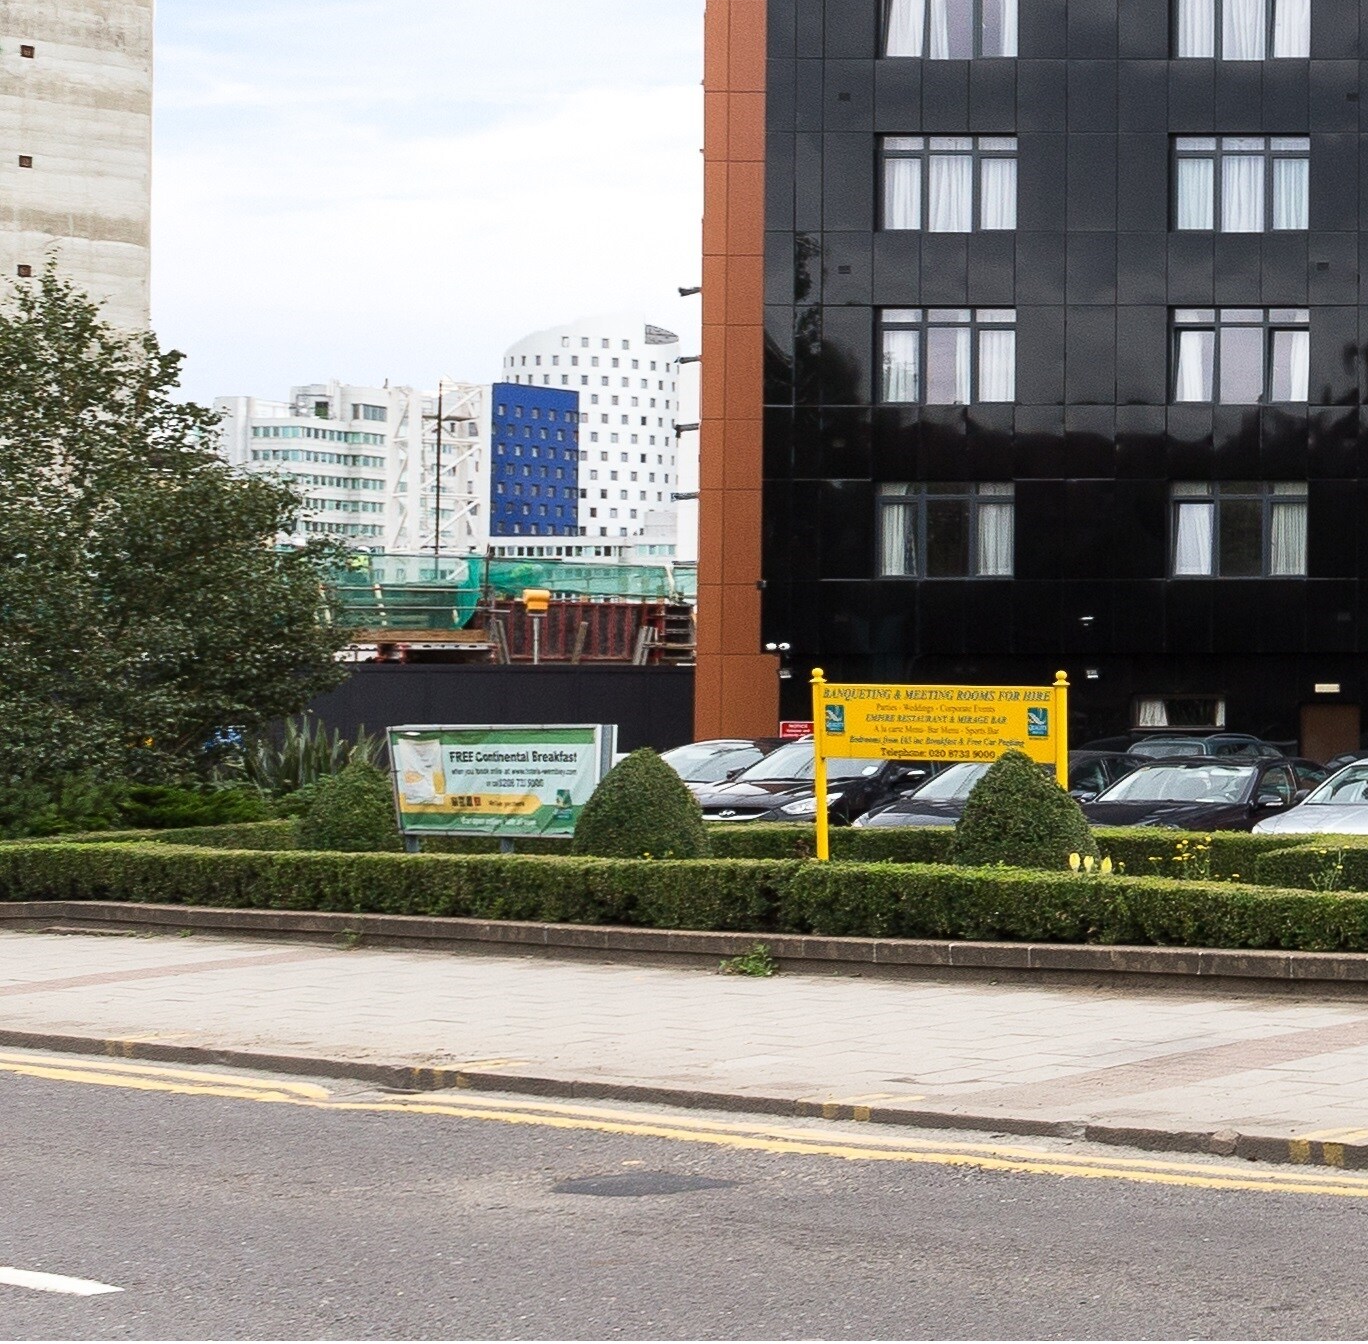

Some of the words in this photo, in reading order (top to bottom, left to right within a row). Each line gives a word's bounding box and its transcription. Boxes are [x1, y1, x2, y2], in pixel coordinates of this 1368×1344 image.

[823, 688, 893, 701] BANQUETING
[894, 690, 901, 699] &
[905, 689, 954, 701] MEETING
[956, 690, 995, 701] ROOMS
[998, 690, 1020, 701] FOR
[1023, 691, 1051, 701] HIRE
[449, 751, 473, 762] FREE
[475, 750, 529, 762] Continental
[532, 750, 577, 762] Breakfast
[928, 749, 946, 757] 020
